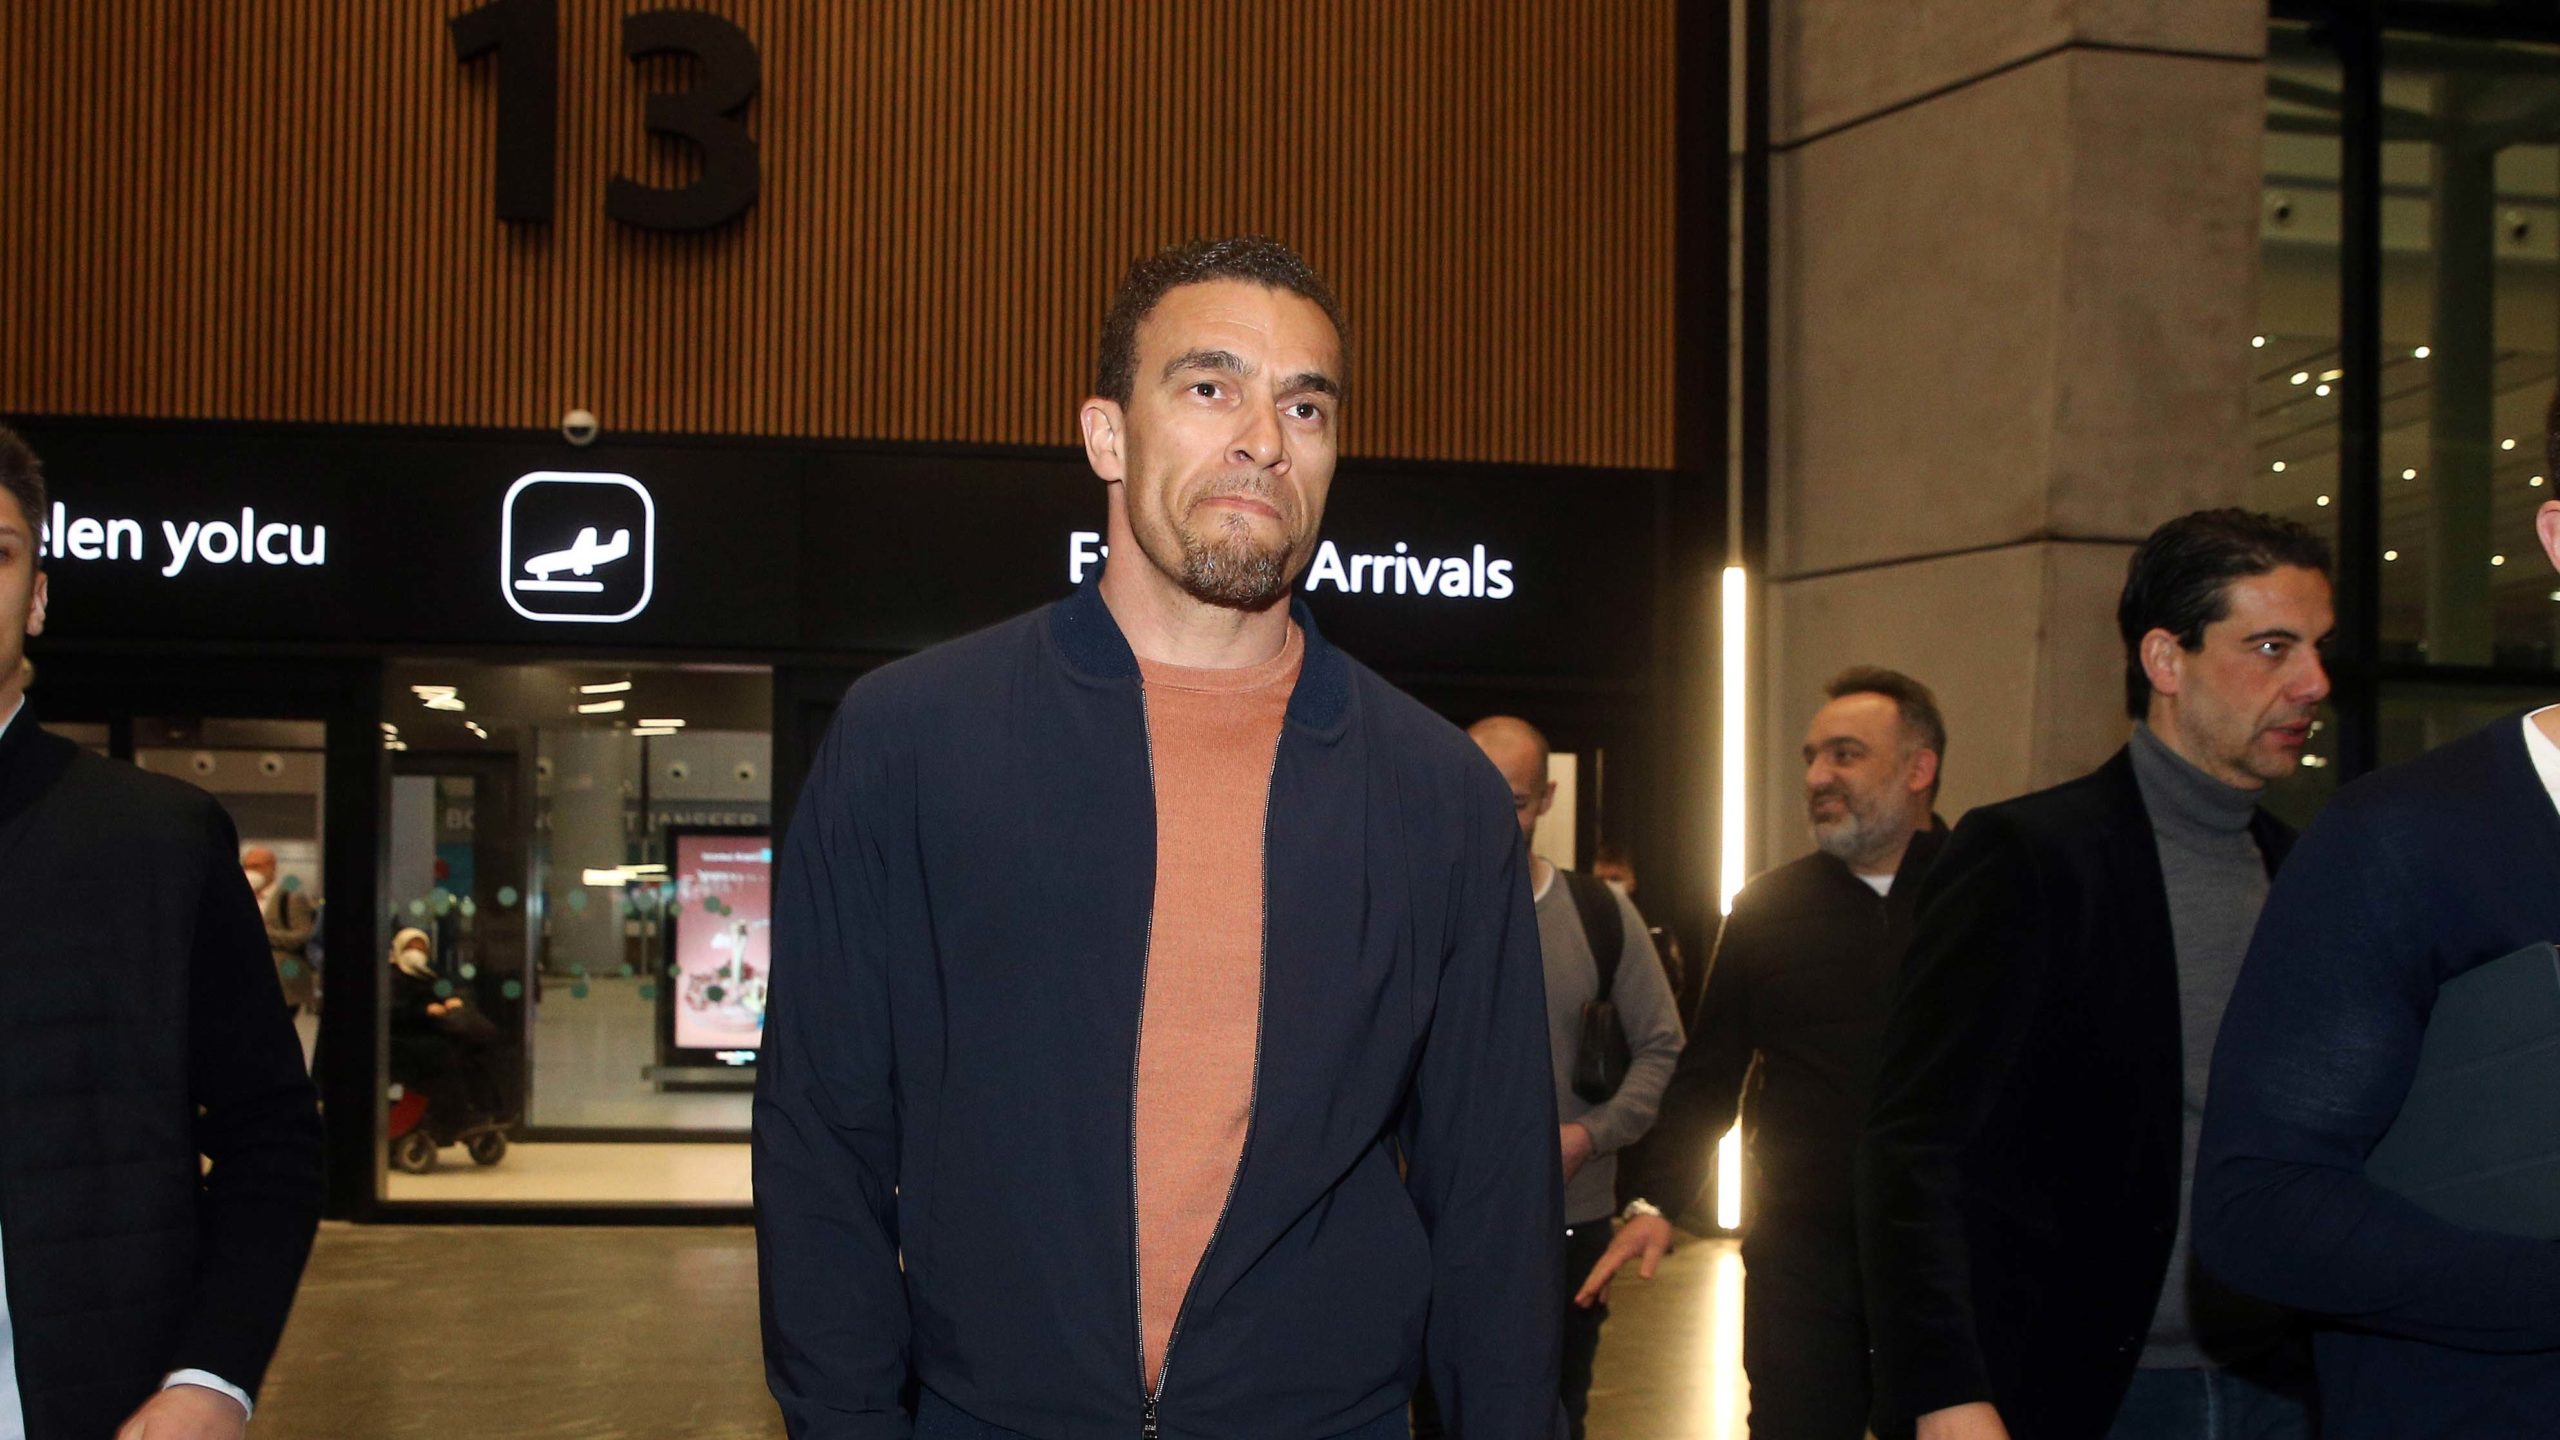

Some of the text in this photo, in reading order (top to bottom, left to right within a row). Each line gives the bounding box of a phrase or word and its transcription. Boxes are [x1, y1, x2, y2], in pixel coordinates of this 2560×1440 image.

[450, 0, 761, 231] 13
[161, 506, 326, 578] yolcu
[1305, 540, 1514, 599] Arrivals
